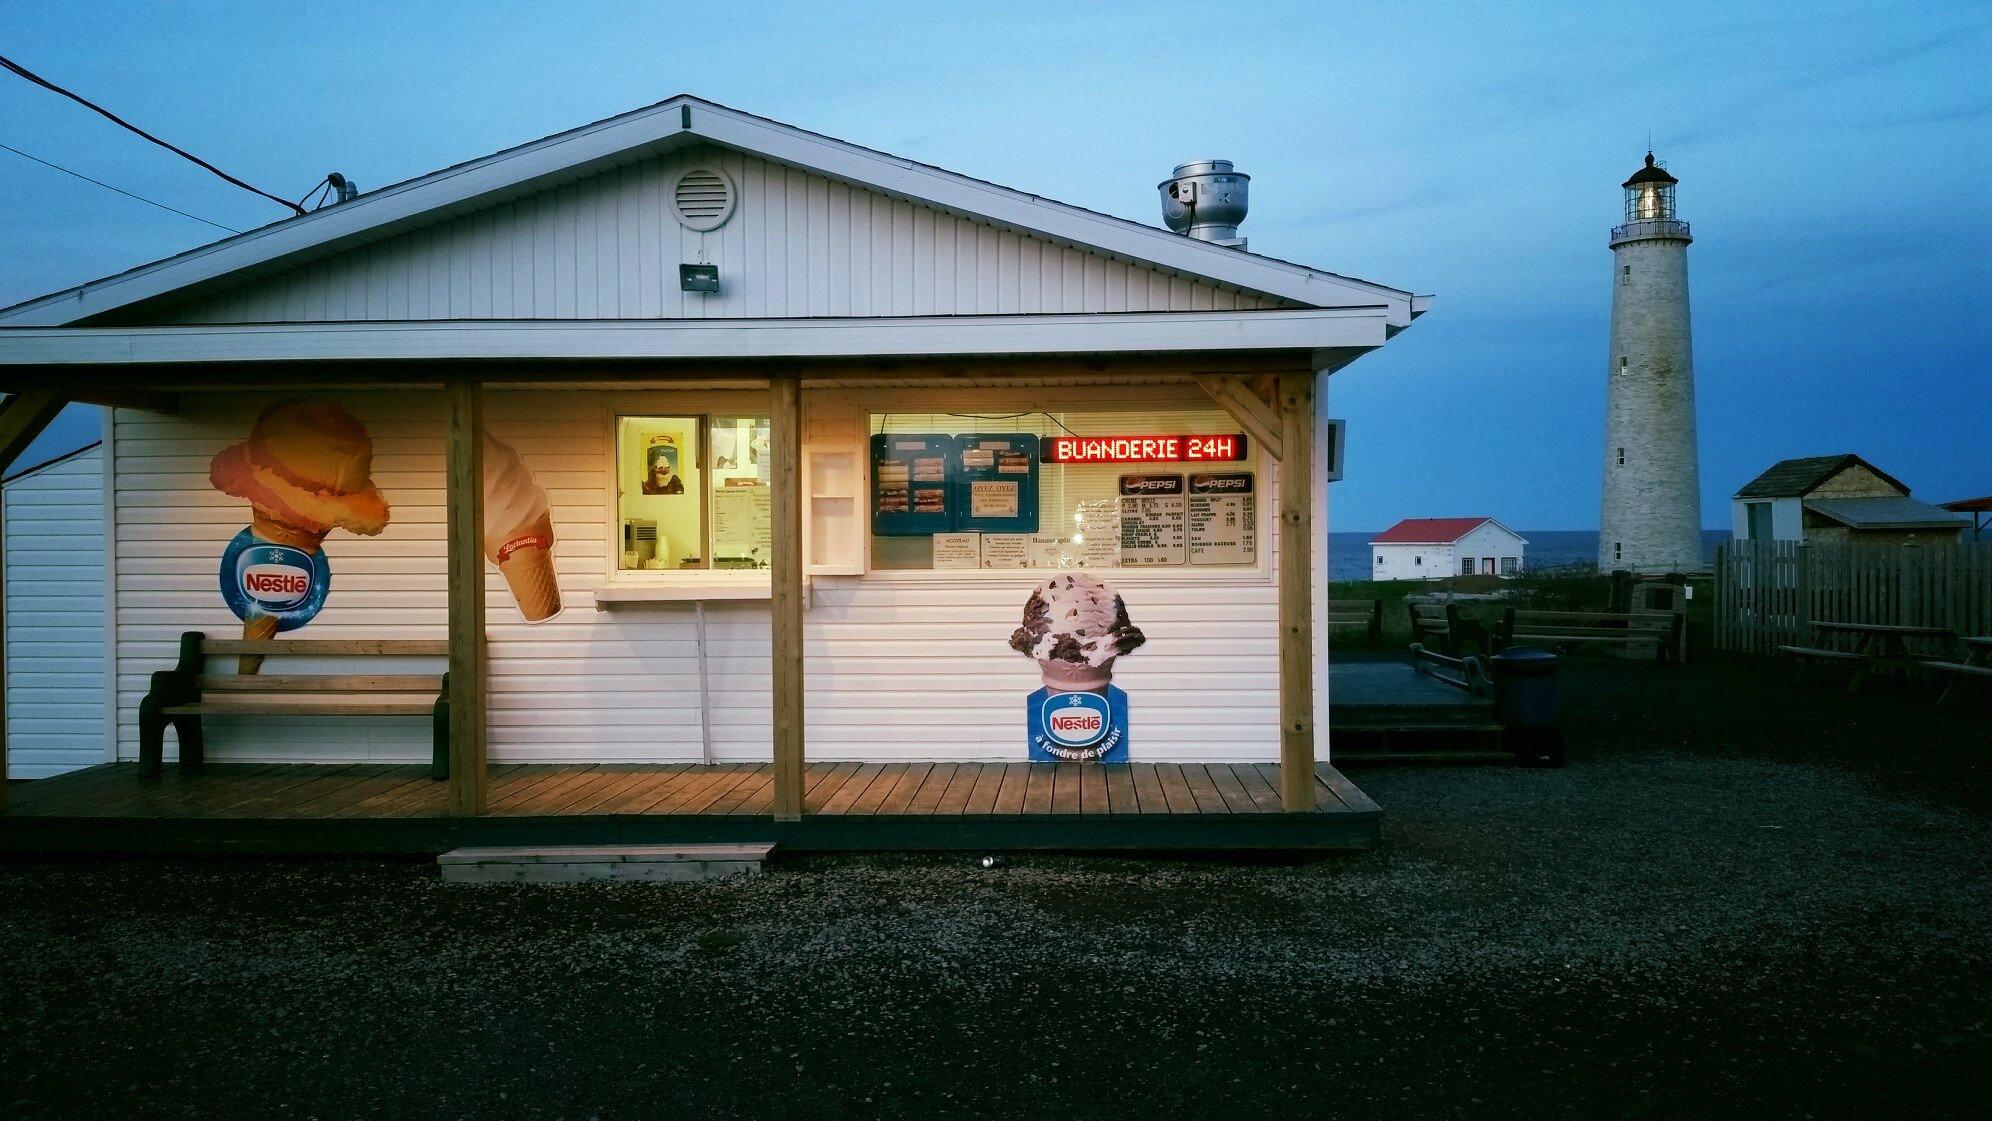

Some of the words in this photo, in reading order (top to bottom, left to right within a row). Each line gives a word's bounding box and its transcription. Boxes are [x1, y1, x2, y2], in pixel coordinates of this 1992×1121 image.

[1057, 438, 1178, 460] BUANDERIE
[1188, 438, 1232, 458] 24H
[1141, 481, 1176, 489] PEPSI
[1210, 480, 1245, 488] PEPSI
[503, 536, 537, 553] Lactantia
[1042, 741, 1078, 760] fondre
[1081, 749, 1095, 759] de
[1097, 726, 1121, 757] plaisir
